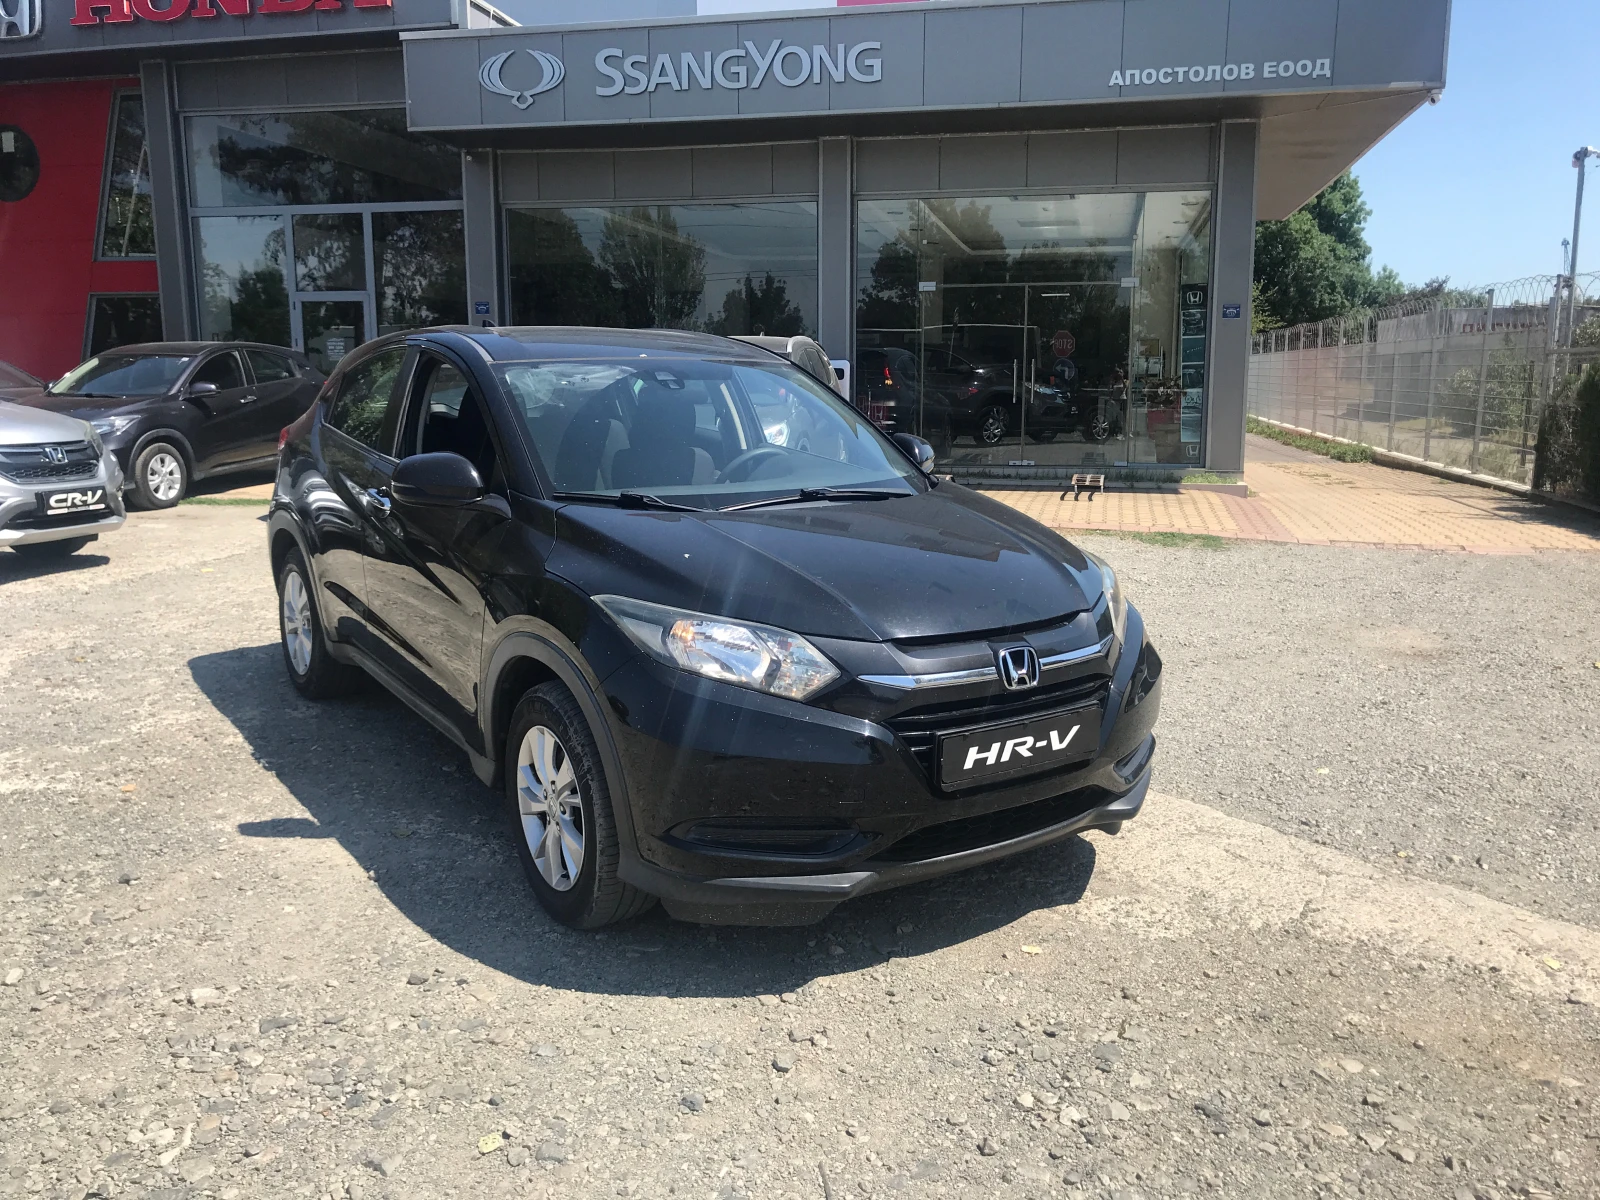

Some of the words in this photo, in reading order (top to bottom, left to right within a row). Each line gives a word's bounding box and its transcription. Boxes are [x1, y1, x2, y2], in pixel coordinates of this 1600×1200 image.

[1108, 63, 1255, 87] АПОСТОЛОВ
[1263, 58, 1331, 79] ЕООД
[49, 489, 103, 508] CR-V
[963, 724, 1081, 770] HR-V
